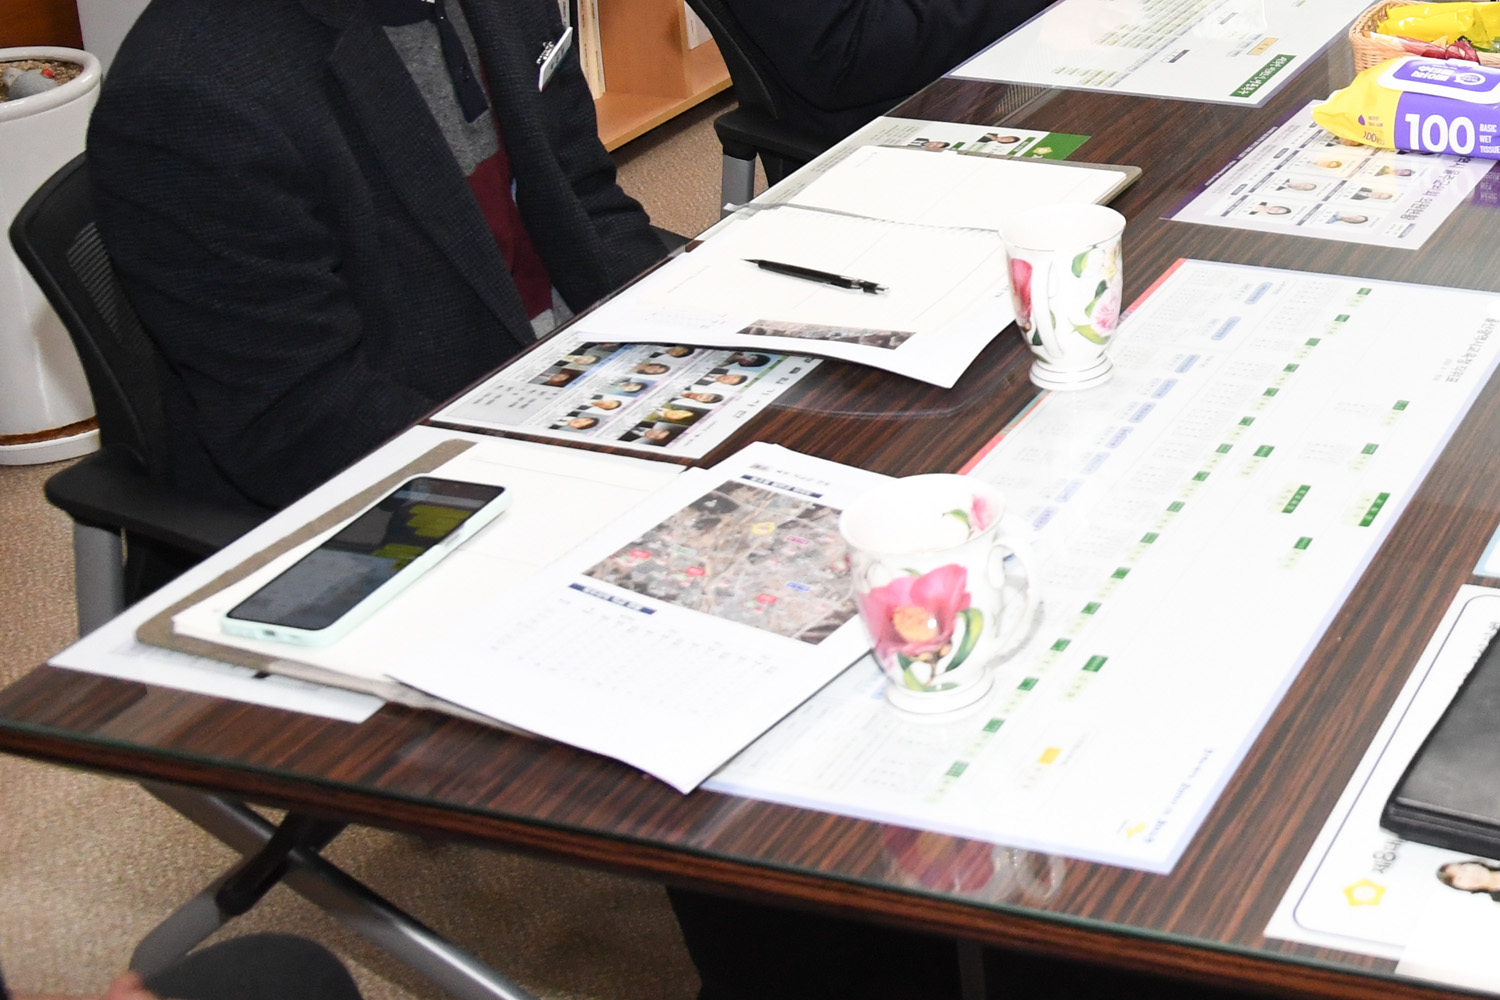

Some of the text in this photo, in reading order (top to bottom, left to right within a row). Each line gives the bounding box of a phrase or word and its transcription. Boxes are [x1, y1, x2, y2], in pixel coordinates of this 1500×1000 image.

[1479, 123, 1498, 133] BASIC
[1405, 113, 1475, 155] 100
[1479, 134, 1492, 144] WET
[1479, 144, 1500, 154] TISSUE
